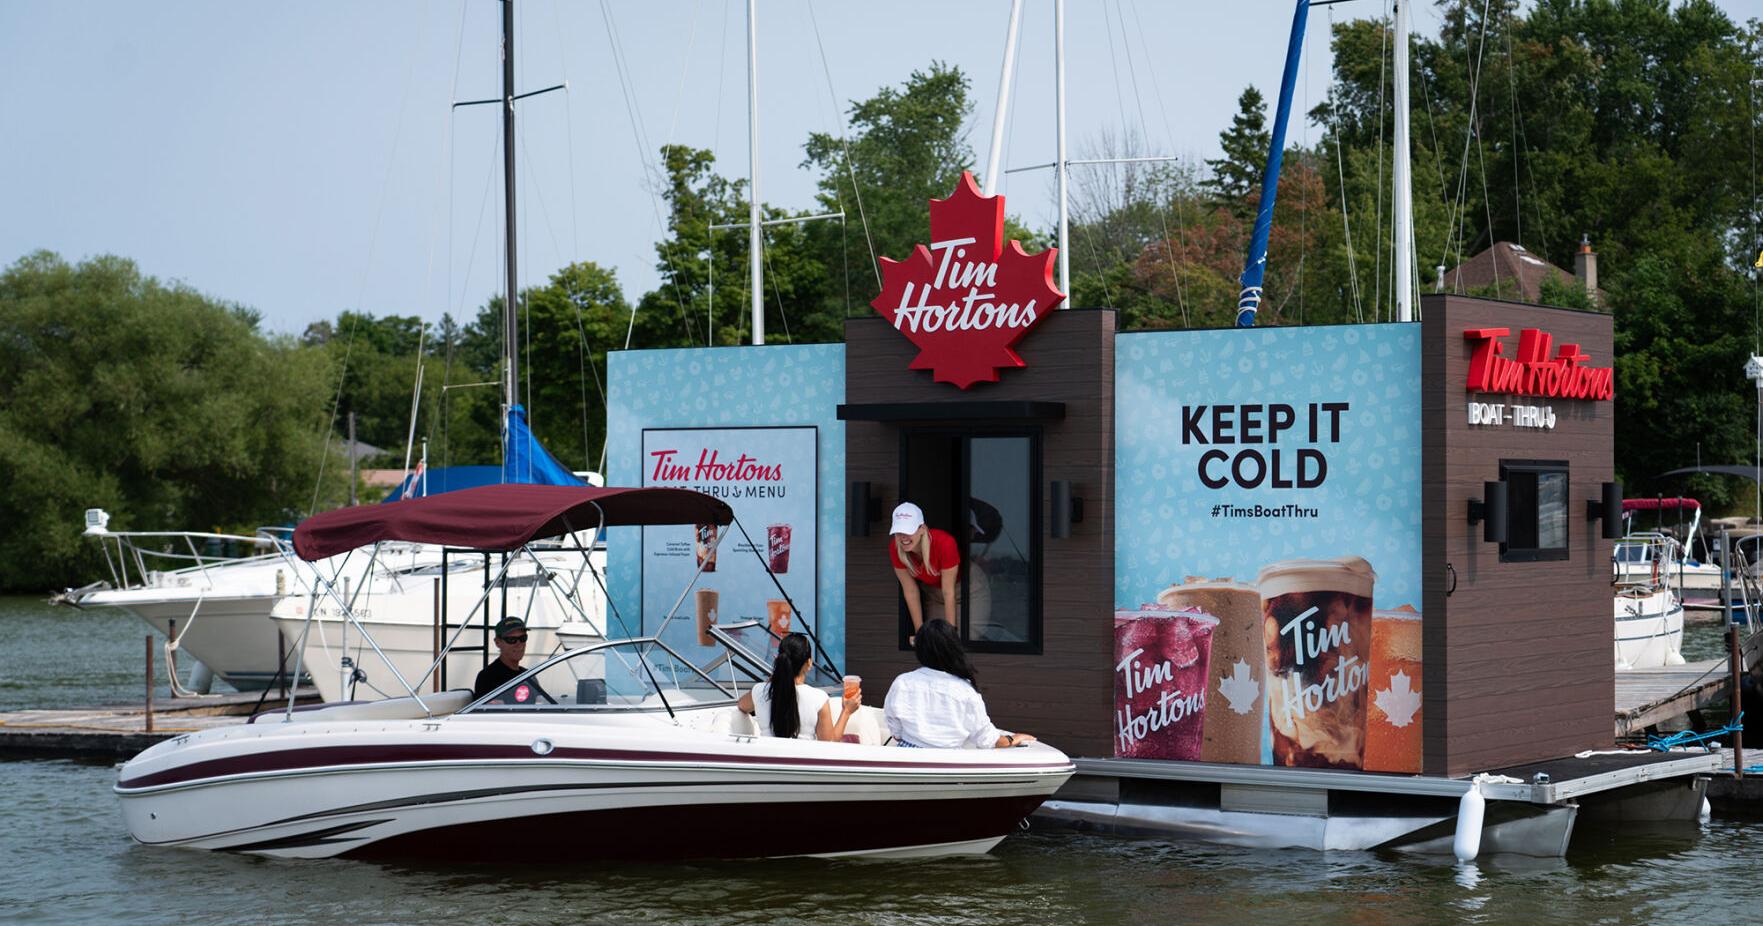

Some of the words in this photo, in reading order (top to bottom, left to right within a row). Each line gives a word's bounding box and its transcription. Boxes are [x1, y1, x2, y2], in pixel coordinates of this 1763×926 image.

[931, 237, 998, 290] Tim
[894, 281, 1037, 333] Hortons
[1464, 328, 1525, 394] Tim
[1517, 328, 1614, 400] Hortons
[1182, 404, 1296, 445] KEEP
[1308, 402, 1350, 443] IT
[651, 450, 691, 481] Tim
[694, 448, 783, 481] Hortons
[1198, 449, 1328, 489] COLD
[745, 486, 787, 498] MENU
[1211, 504, 1318, 518] #TimsBoatThru
[1280, 606, 1351, 665] Tim
[1116, 648, 1173, 698] Tim
[1118, 688, 1205, 752] Hortons
